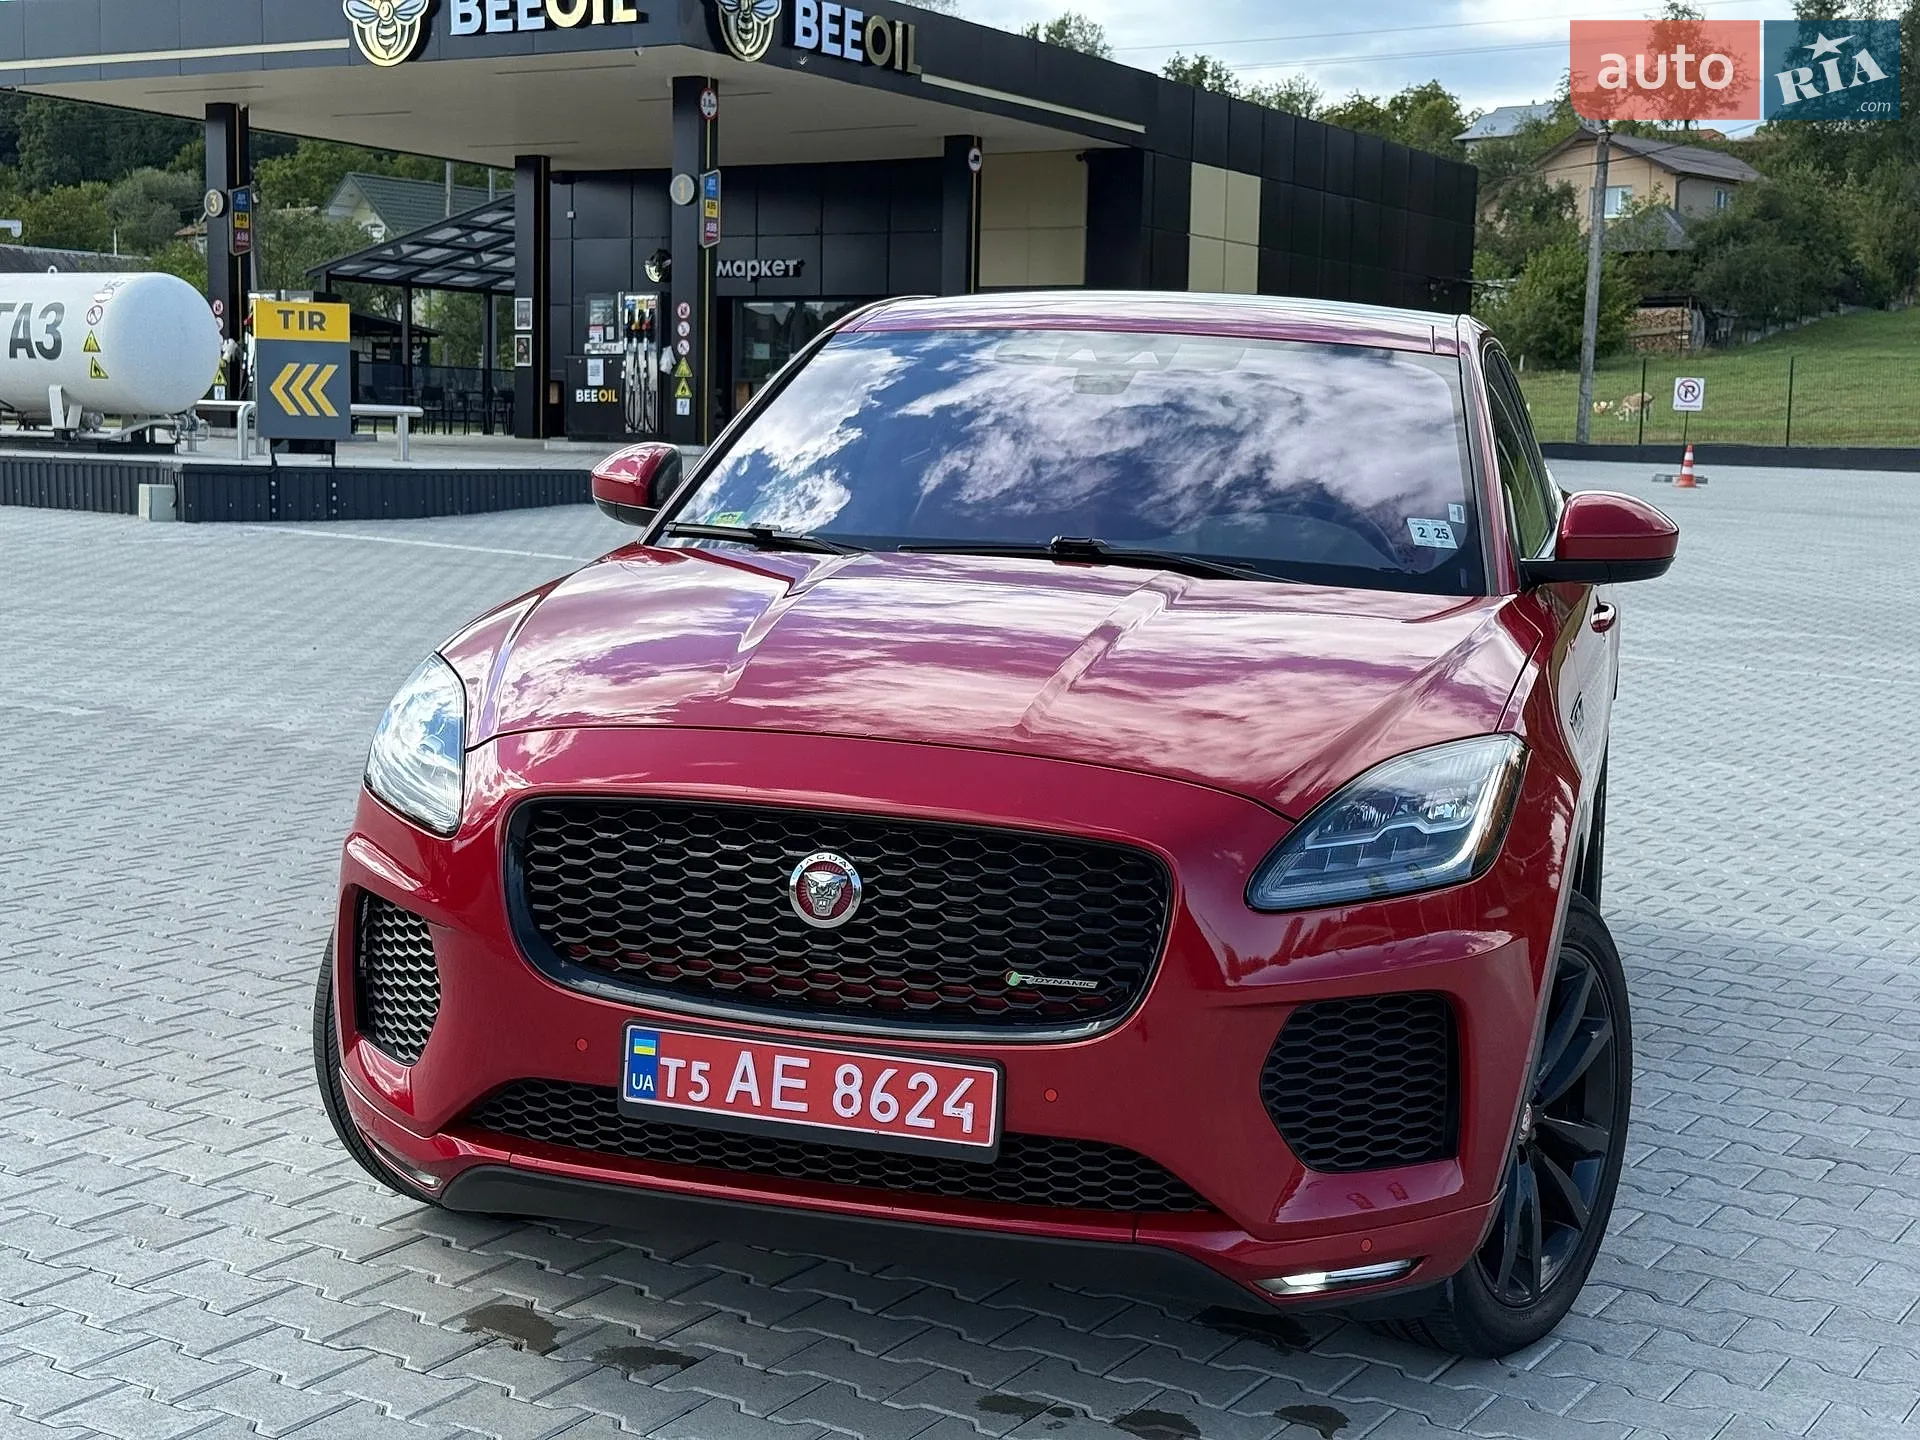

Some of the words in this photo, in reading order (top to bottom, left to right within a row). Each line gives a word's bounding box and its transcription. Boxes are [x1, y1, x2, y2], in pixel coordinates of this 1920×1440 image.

[794, 0, 922, 75] BEEOIL
[209, 194, 218, 213] 3
[716, 260, 798, 282] маркет
[277, 310, 326, 331] TIR
[575, 389, 618, 403] BEEOIL
[1417, 527, 1427, 538] 2
[1433, 528, 1449, 540] 25
[797, 853, 857, 877] JAGUAR
[631, 1073, 654, 1092] UA
[725, 1050, 811, 1113] AE
[832, 1063, 975, 1134] 8624
